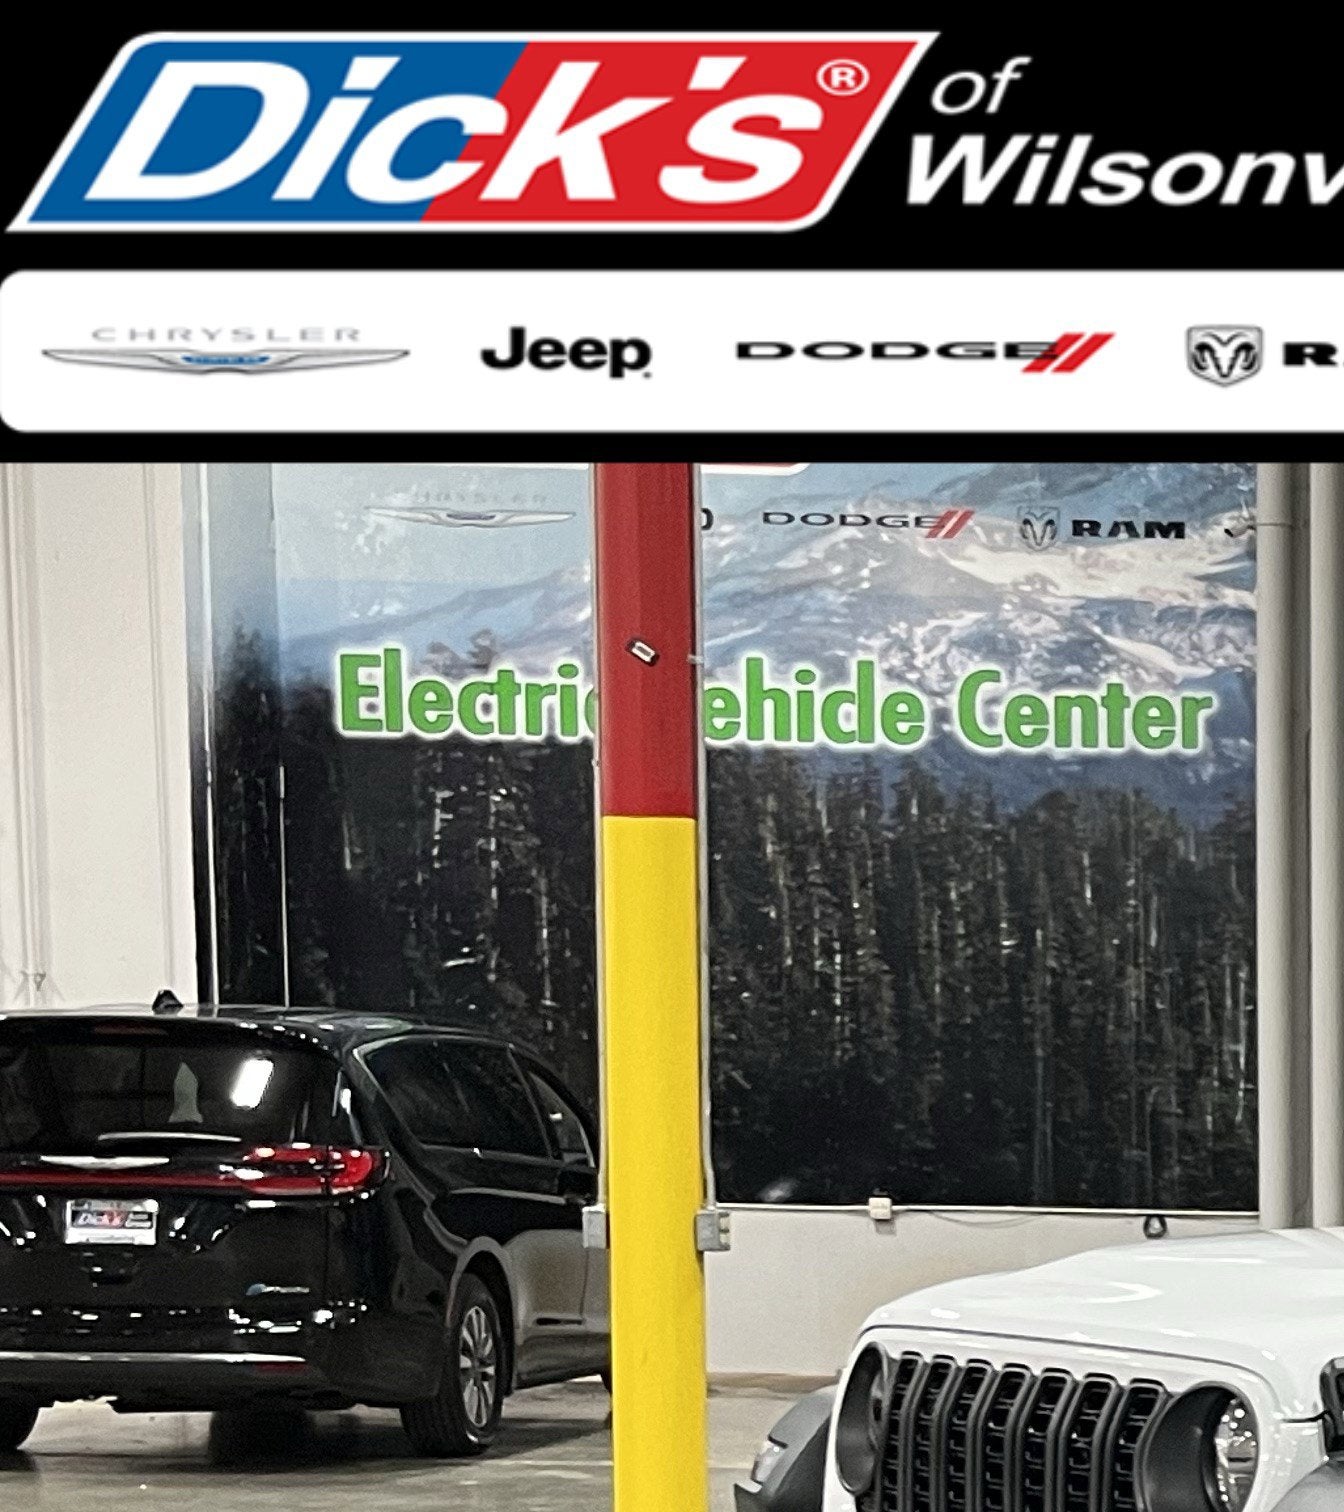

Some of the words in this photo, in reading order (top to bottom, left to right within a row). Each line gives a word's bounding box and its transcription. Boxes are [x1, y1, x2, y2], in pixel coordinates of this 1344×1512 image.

[762, 511, 946, 529] DODGE
[1071, 519, 1186, 539] RAM
[341, 647, 599, 738] Electri
[703, 656, 926, 744] ehicle
[957, 668, 1214, 750] Center
